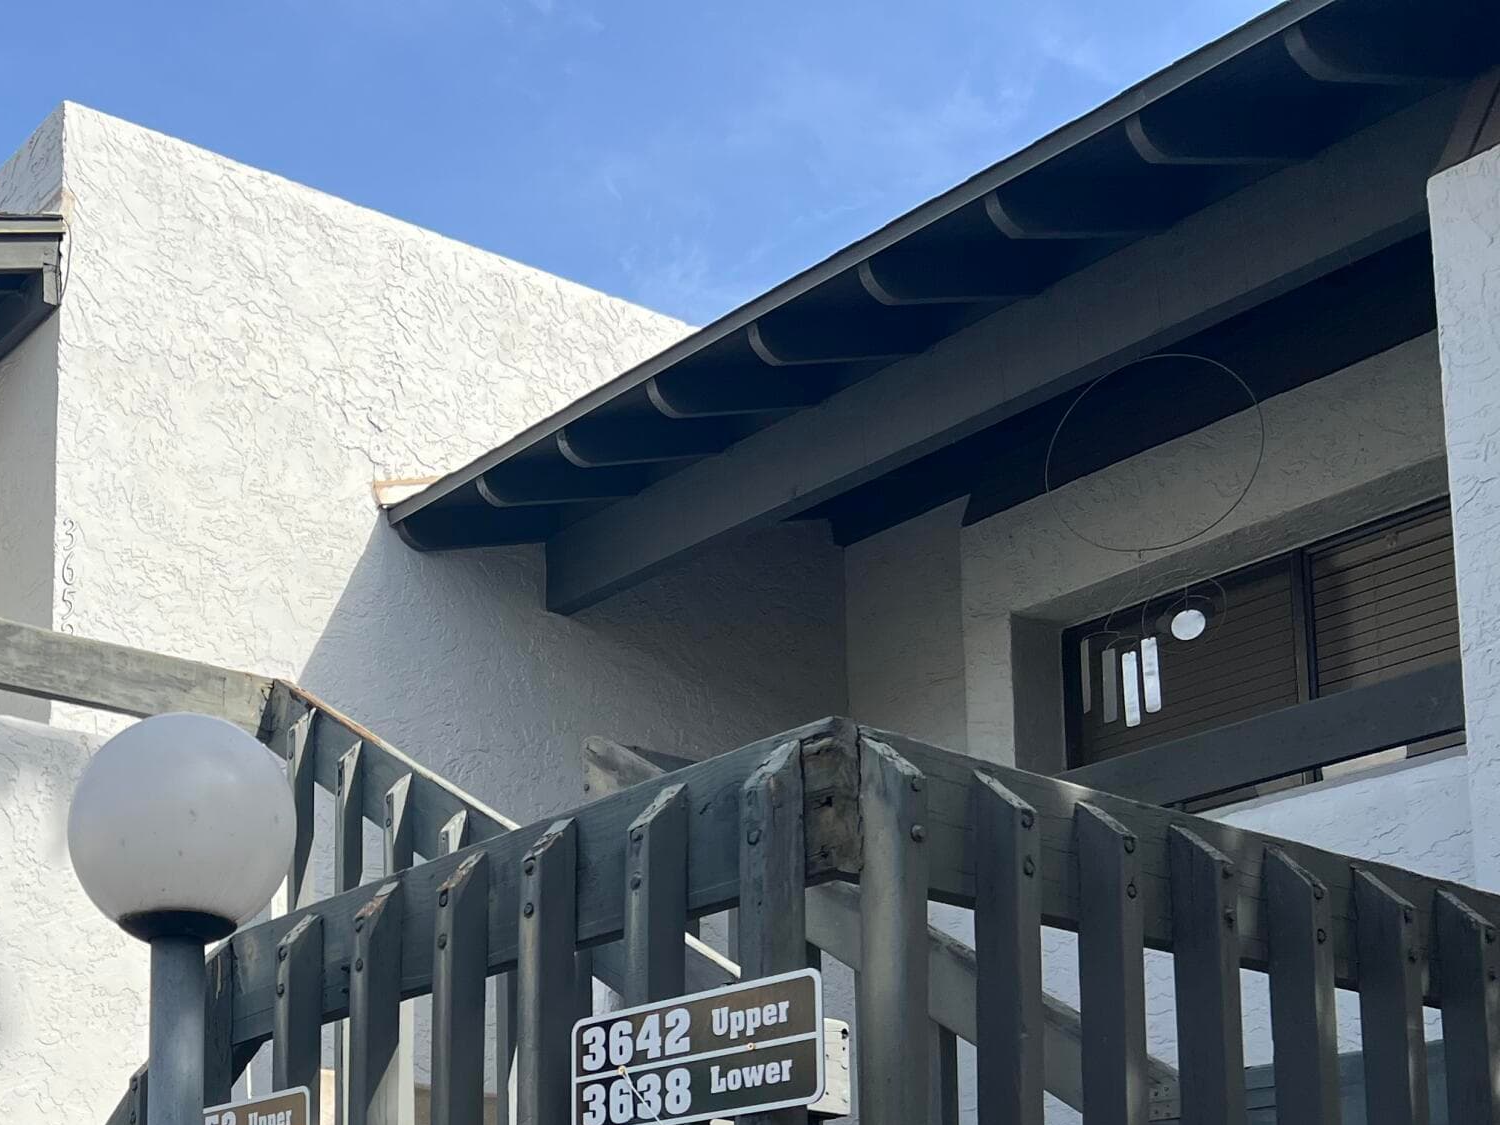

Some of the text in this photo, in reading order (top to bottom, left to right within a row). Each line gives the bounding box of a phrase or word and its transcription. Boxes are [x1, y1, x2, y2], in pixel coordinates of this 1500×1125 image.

[582, 1000, 790, 1071] 3642 Upper
[710, 1059, 792, 1094] Lower
